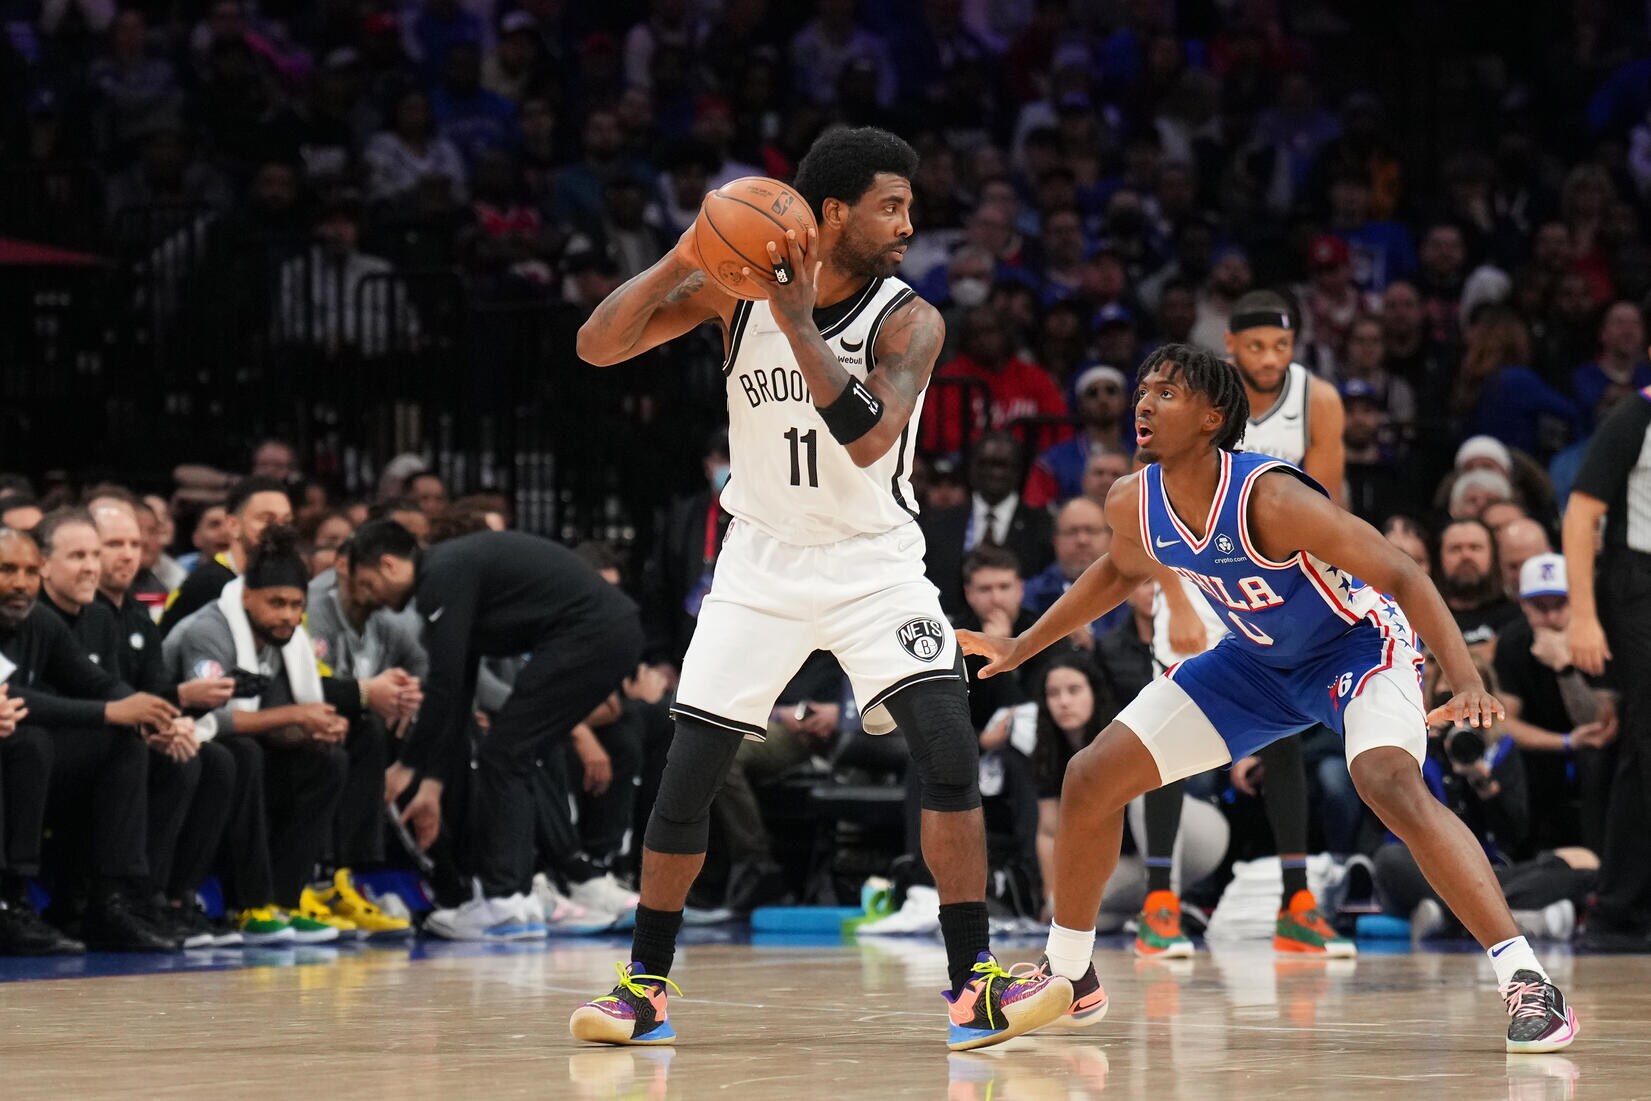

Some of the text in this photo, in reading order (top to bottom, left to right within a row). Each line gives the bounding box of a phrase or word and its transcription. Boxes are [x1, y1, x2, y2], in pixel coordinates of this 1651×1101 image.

[837, 355, 863, 365] Webull
[853, 383, 873, 405] 11
[784, 427, 819, 488] 11
[1214, 556, 1248, 565] crypto.com
[900, 620, 943, 646] NETS
[921, 639, 932, 655] B
[1338, 671, 1354, 698] 6
